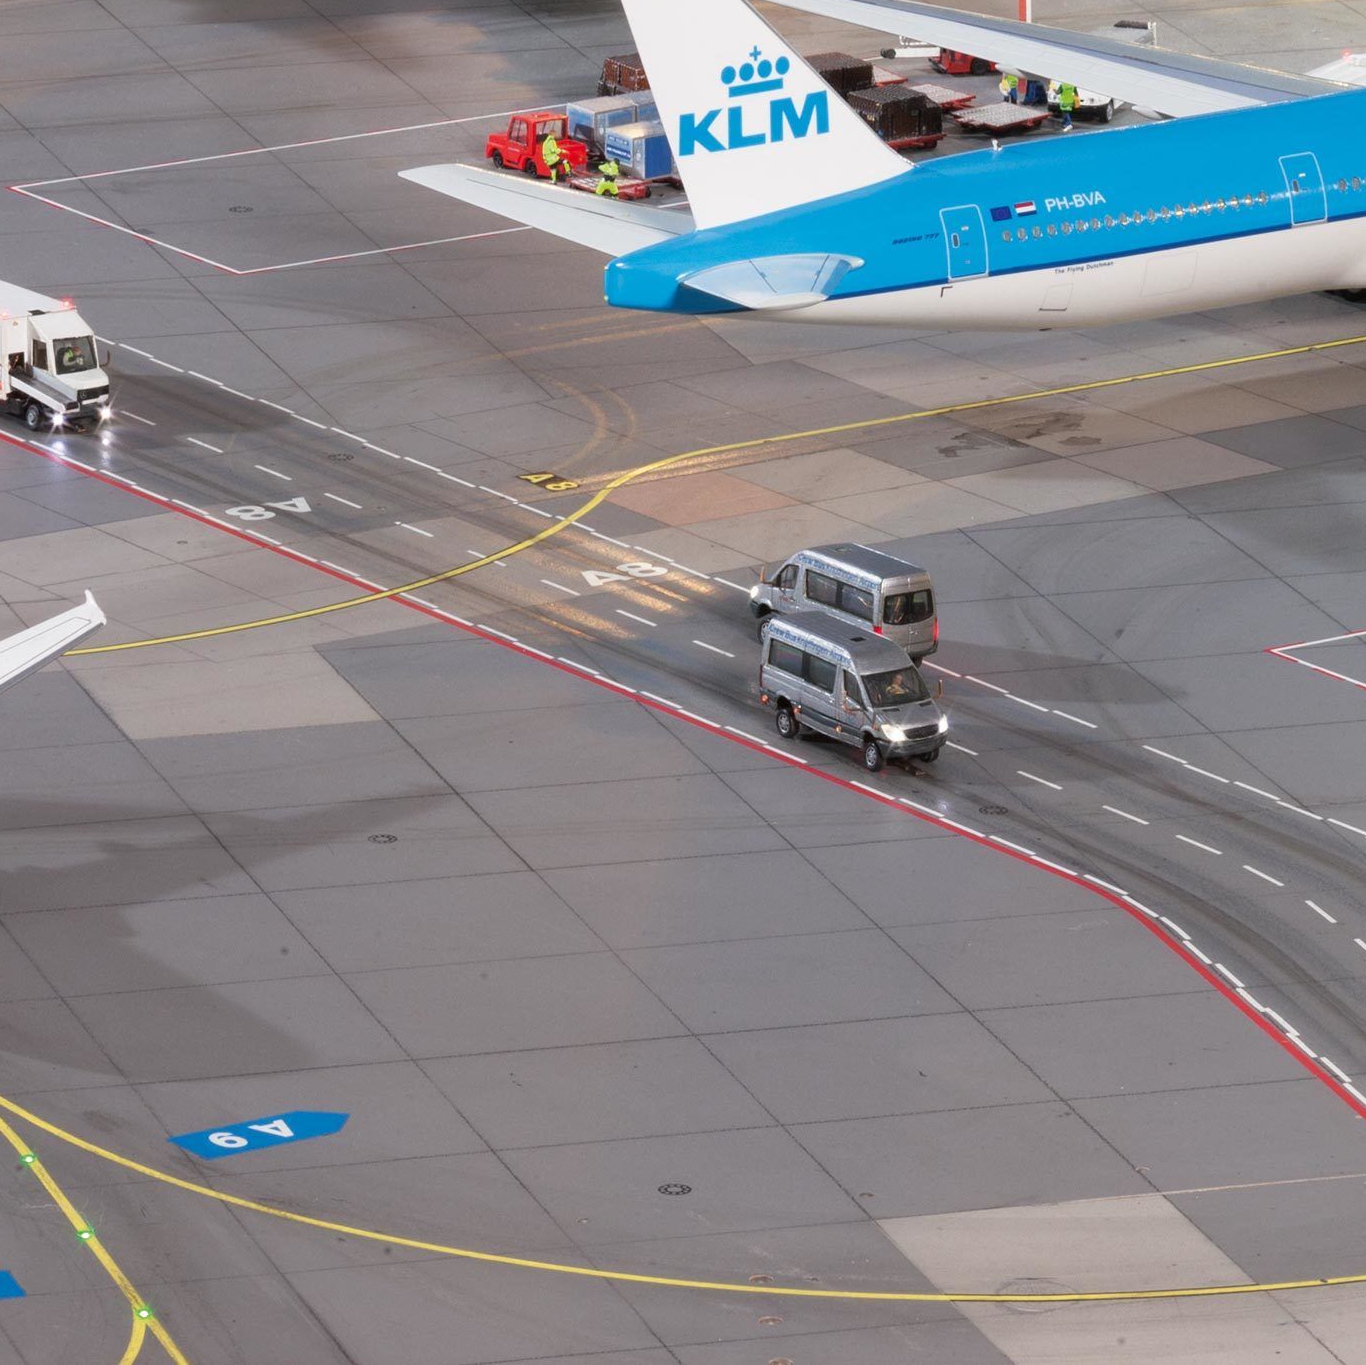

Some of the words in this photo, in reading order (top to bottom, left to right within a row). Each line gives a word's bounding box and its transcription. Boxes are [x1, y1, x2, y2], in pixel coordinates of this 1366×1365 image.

[679, 90, 830, 157] KLM
[1044, 190, 1107, 213] PH-BVA
[581, 562, 669, 586] A8
